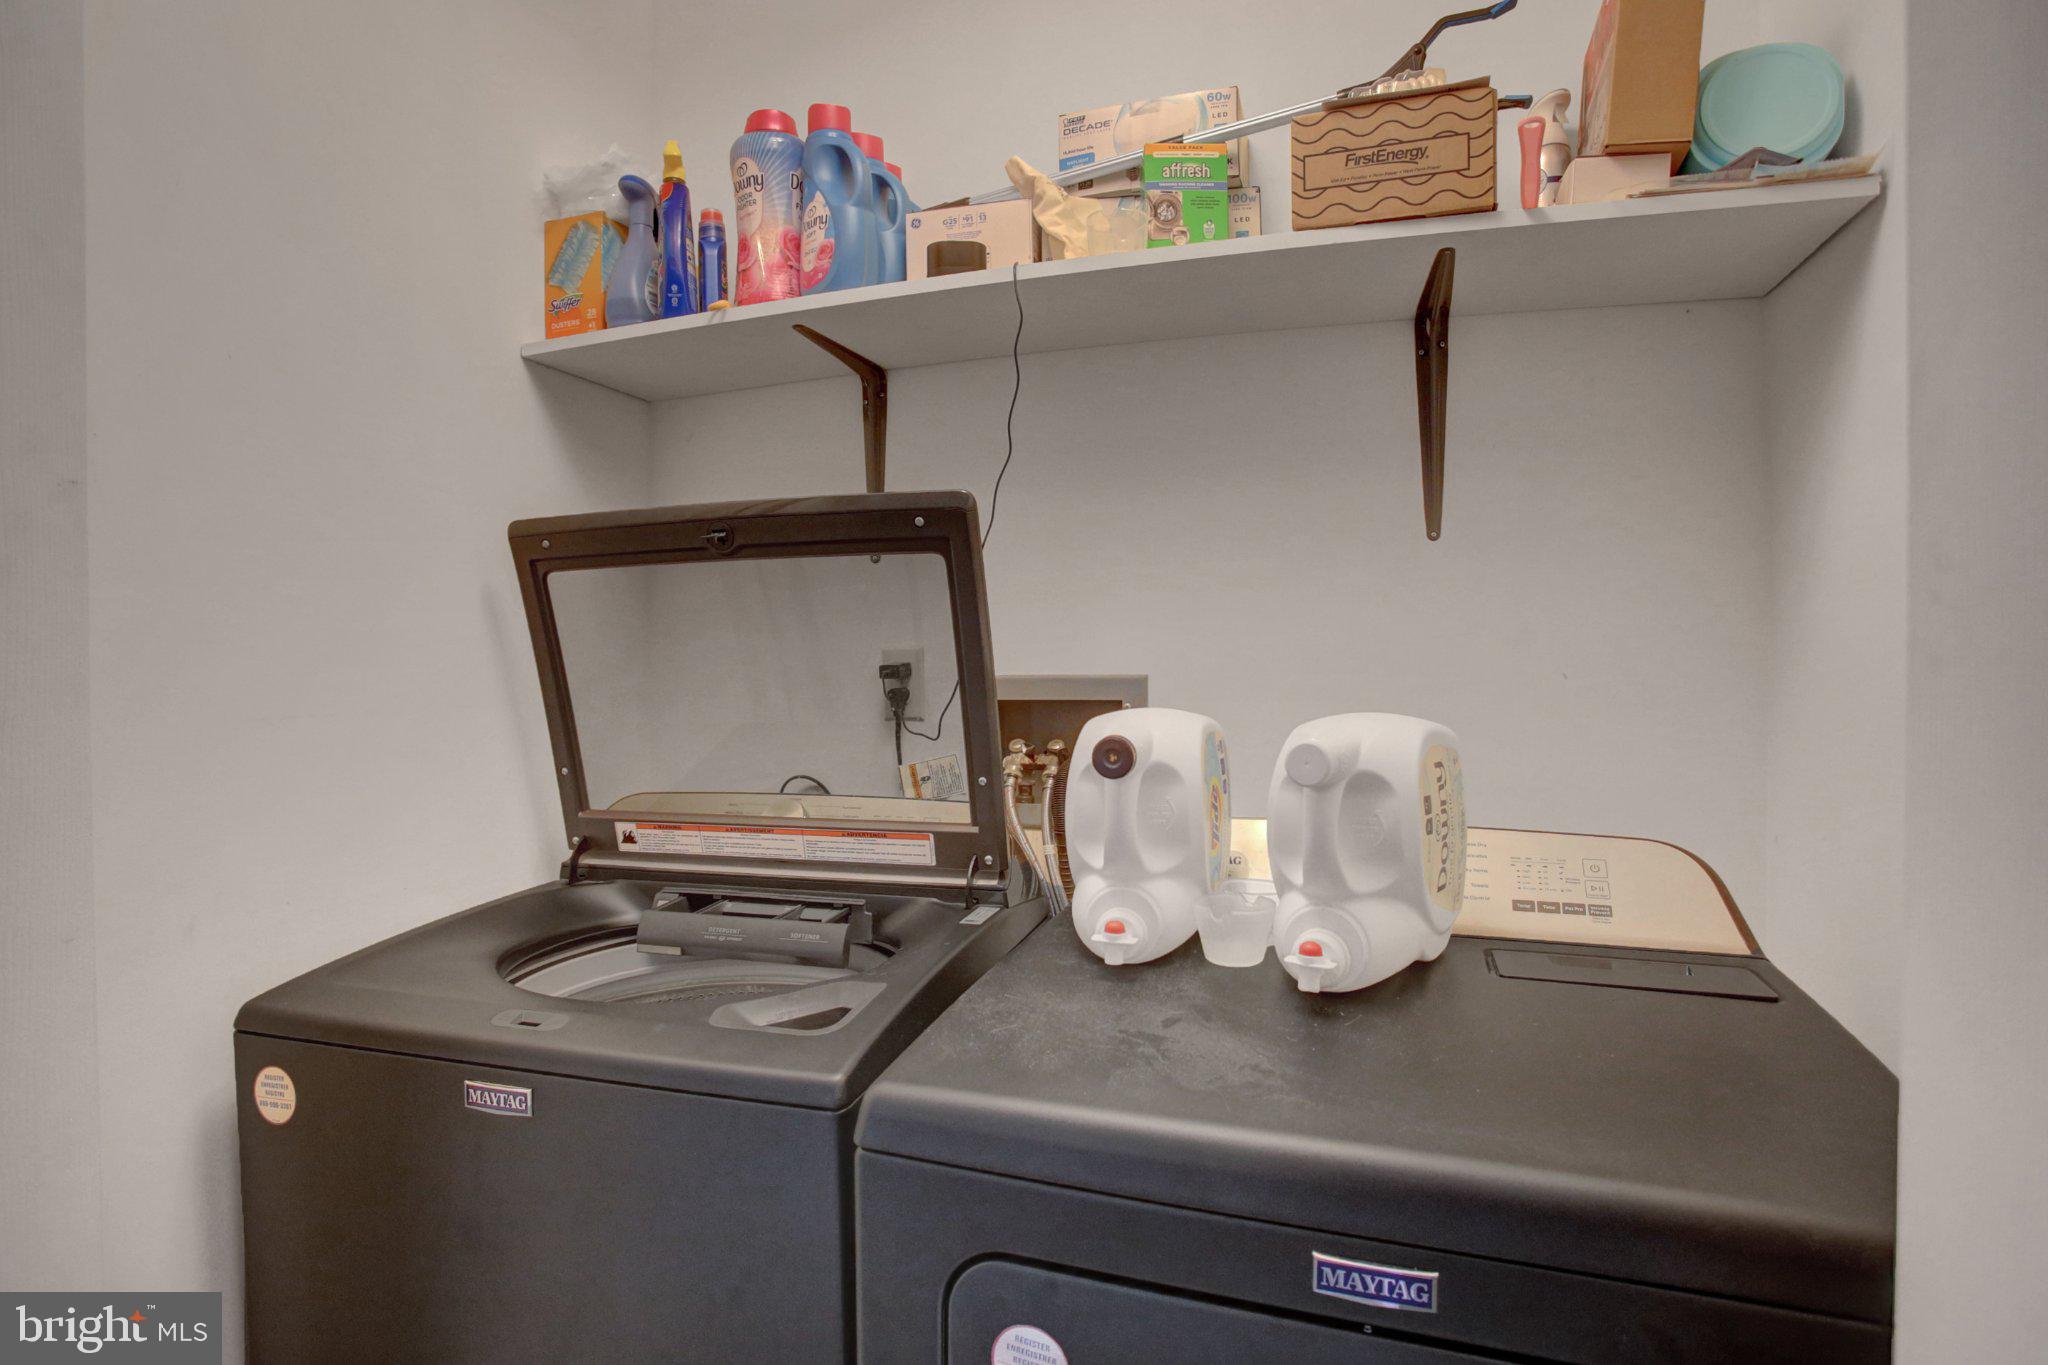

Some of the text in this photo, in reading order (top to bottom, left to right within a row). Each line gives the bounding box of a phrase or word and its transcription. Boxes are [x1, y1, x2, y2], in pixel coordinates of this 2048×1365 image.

[1212, 111, 1228, 119] LED
[1062, 119, 1111, 136] DECADE
[1162, 161, 1211, 178] affresh
[734, 173, 764, 194] owny
[548, 296, 582, 313] Swiffer
[845, 831, 888, 839] ADVERTENCIA
[1433, 760, 1449, 893] Downy
[790, 932, 821, 940] SOFTENER
[264, 1073, 285, 1082] REGISTER
[467, 1088, 526, 1111] MAYTAG
[1320, 1265, 1430, 1304] MAYTAG
[1014, 1333, 1051, 1352] REGISTER
[1006, 1342, 1057, 1365] ENREGISTRER
